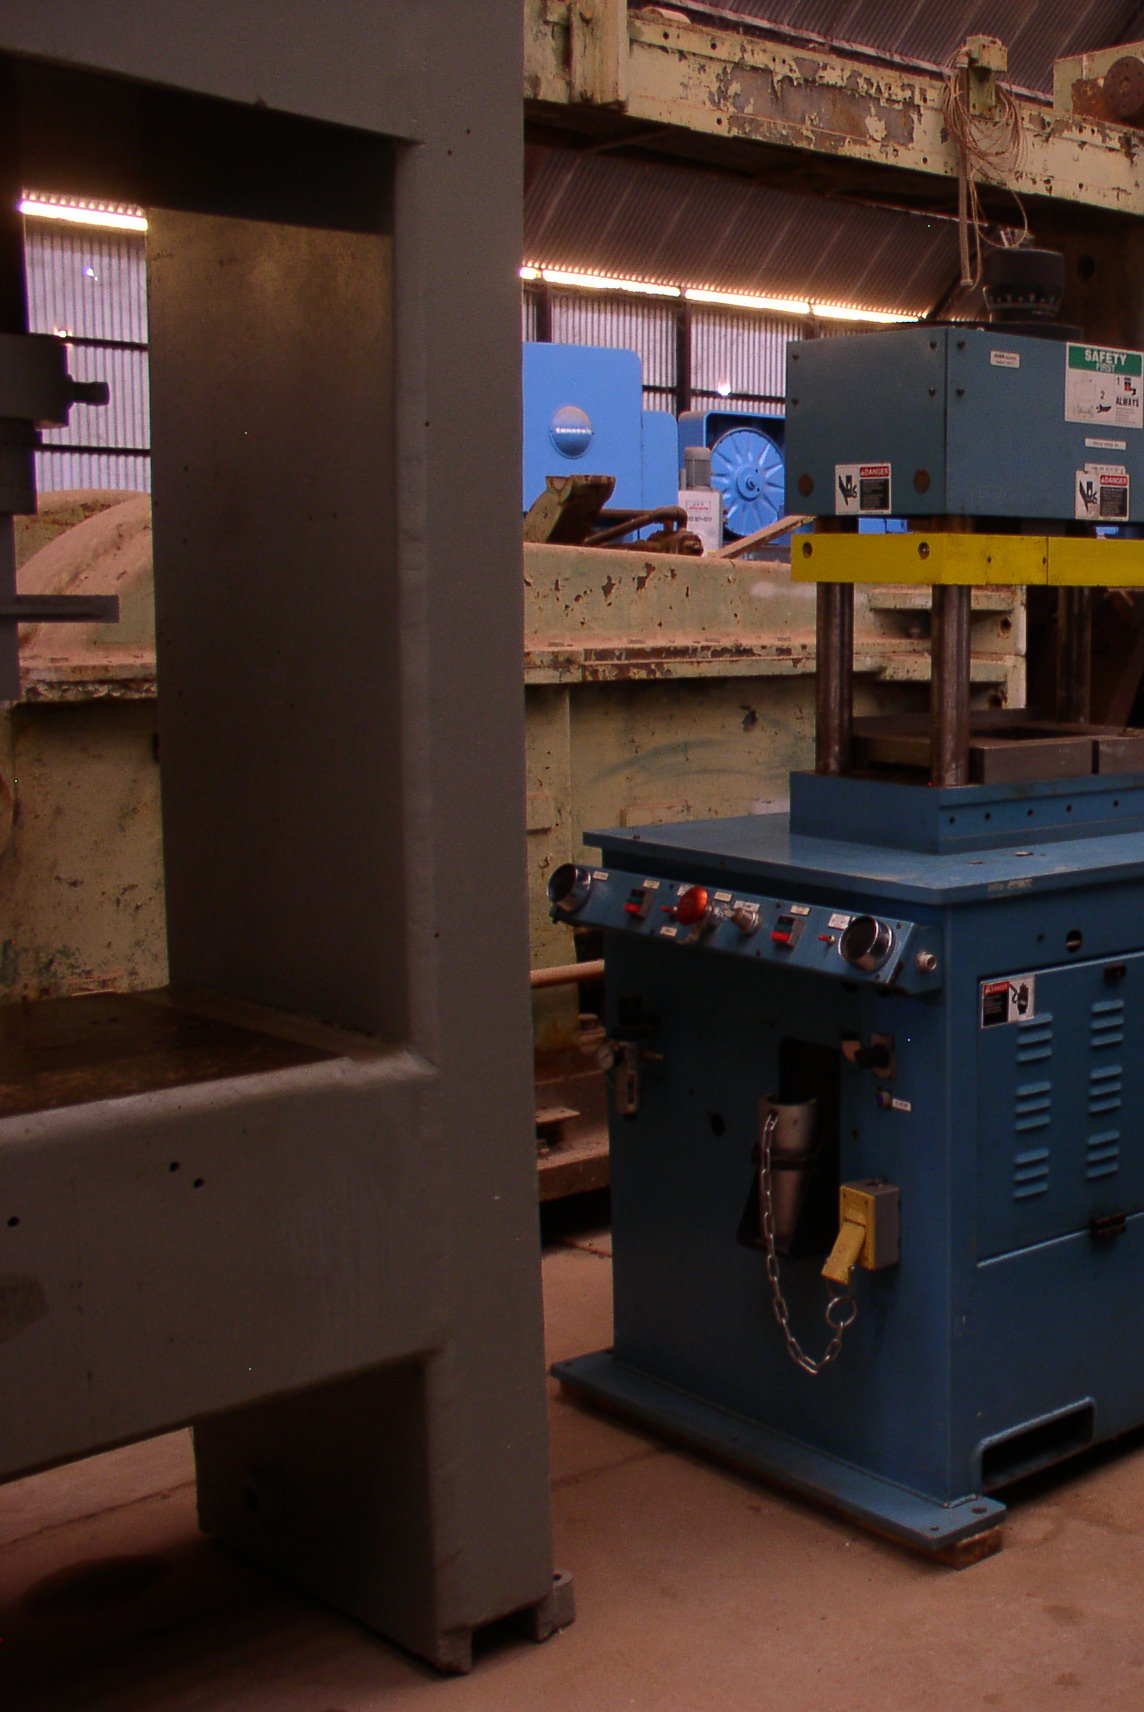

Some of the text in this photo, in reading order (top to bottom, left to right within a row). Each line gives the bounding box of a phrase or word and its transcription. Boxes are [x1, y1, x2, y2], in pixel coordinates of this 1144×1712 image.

[1084, 348, 1128, 366] SAFETY
[1095, 363, 1116, 373] FIRST
[1115, 396, 1140, 408] ALWAYS
